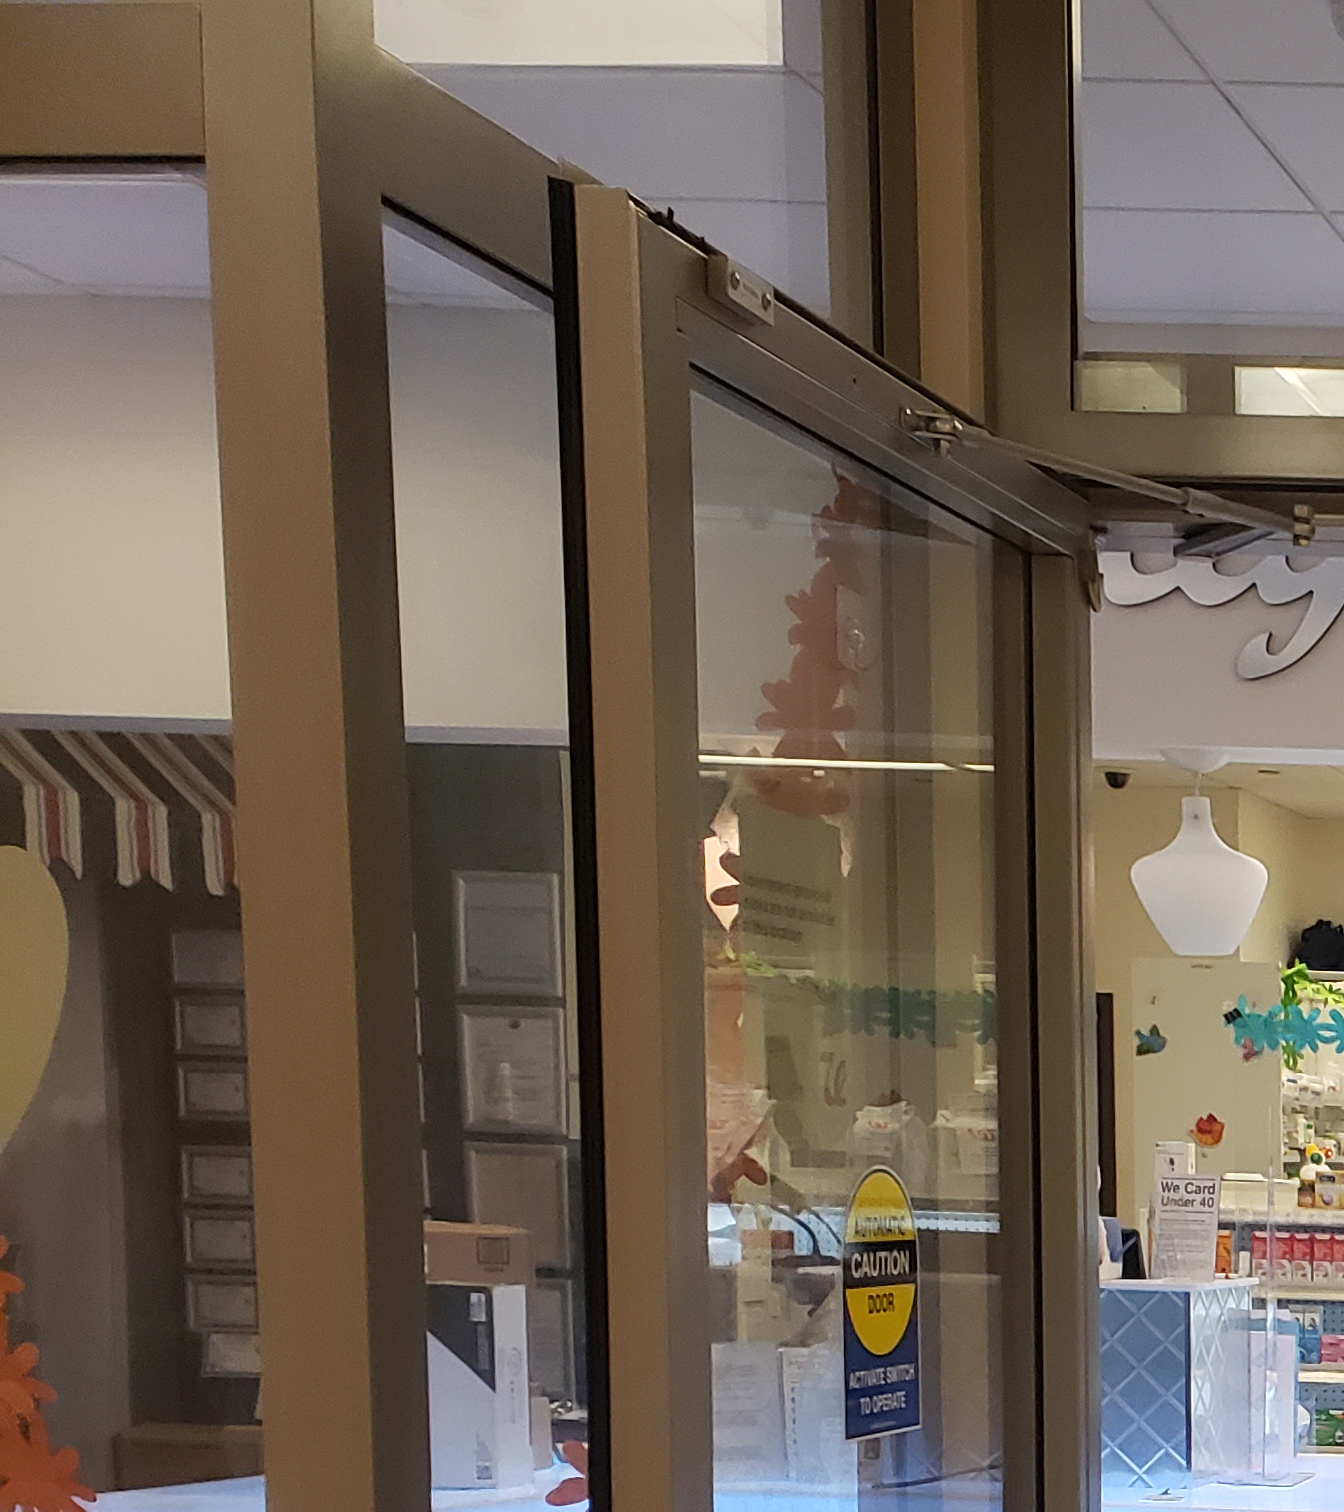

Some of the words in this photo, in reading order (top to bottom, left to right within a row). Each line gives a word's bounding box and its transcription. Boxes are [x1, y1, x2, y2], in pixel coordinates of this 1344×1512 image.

[1161, 1181, 1180, 1194] We
[1184, 1181, 1216, 1195] Card
[1161, 1195, 1196, 1208] Under
[1200, 1196, 1215, 1208] 40
[851, 1250, 910, 1279] CAUTION
[867, 1292, 895, 1315] DOOR
[849, 1367, 886, 1391] ACTIVATE
[886, 1363, 915, 1386] SWITCH
[859, 1398, 872, 1415] TO
[872, 1391, 907, 1414] OPERATE
